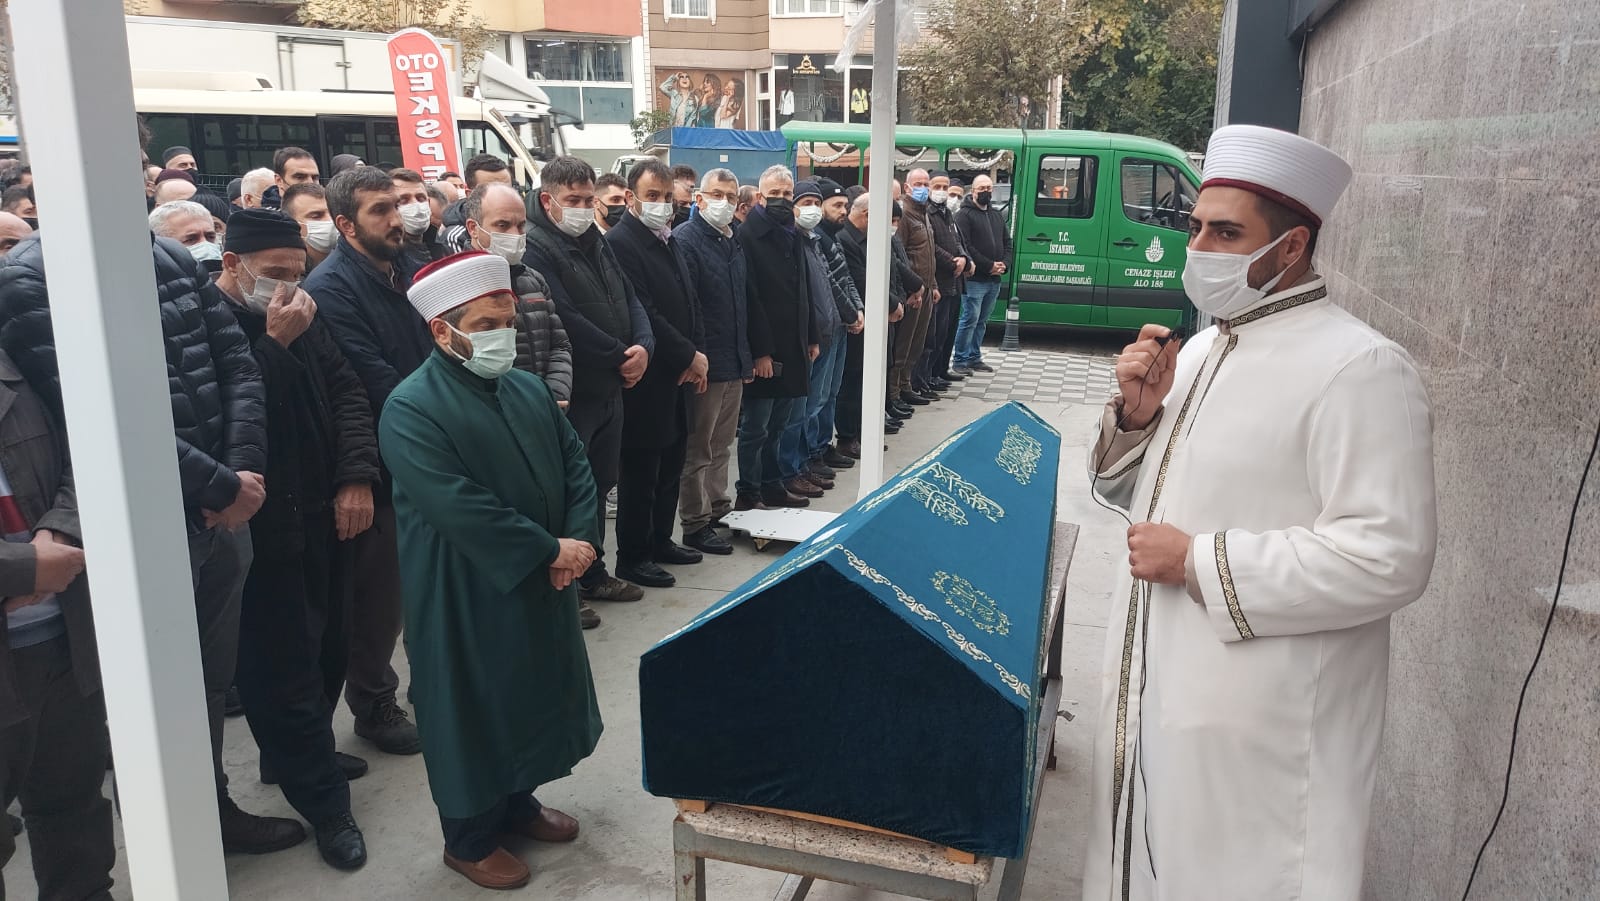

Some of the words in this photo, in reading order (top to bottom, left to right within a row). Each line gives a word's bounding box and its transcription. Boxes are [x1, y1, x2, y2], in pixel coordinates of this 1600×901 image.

[1058, 231, 1070, 242] T.C.
[1049, 243, 1076, 255] İSTANBUL
[1124, 268, 1153, 277] CENAZE
[1133, 279, 1149, 288] ALO
